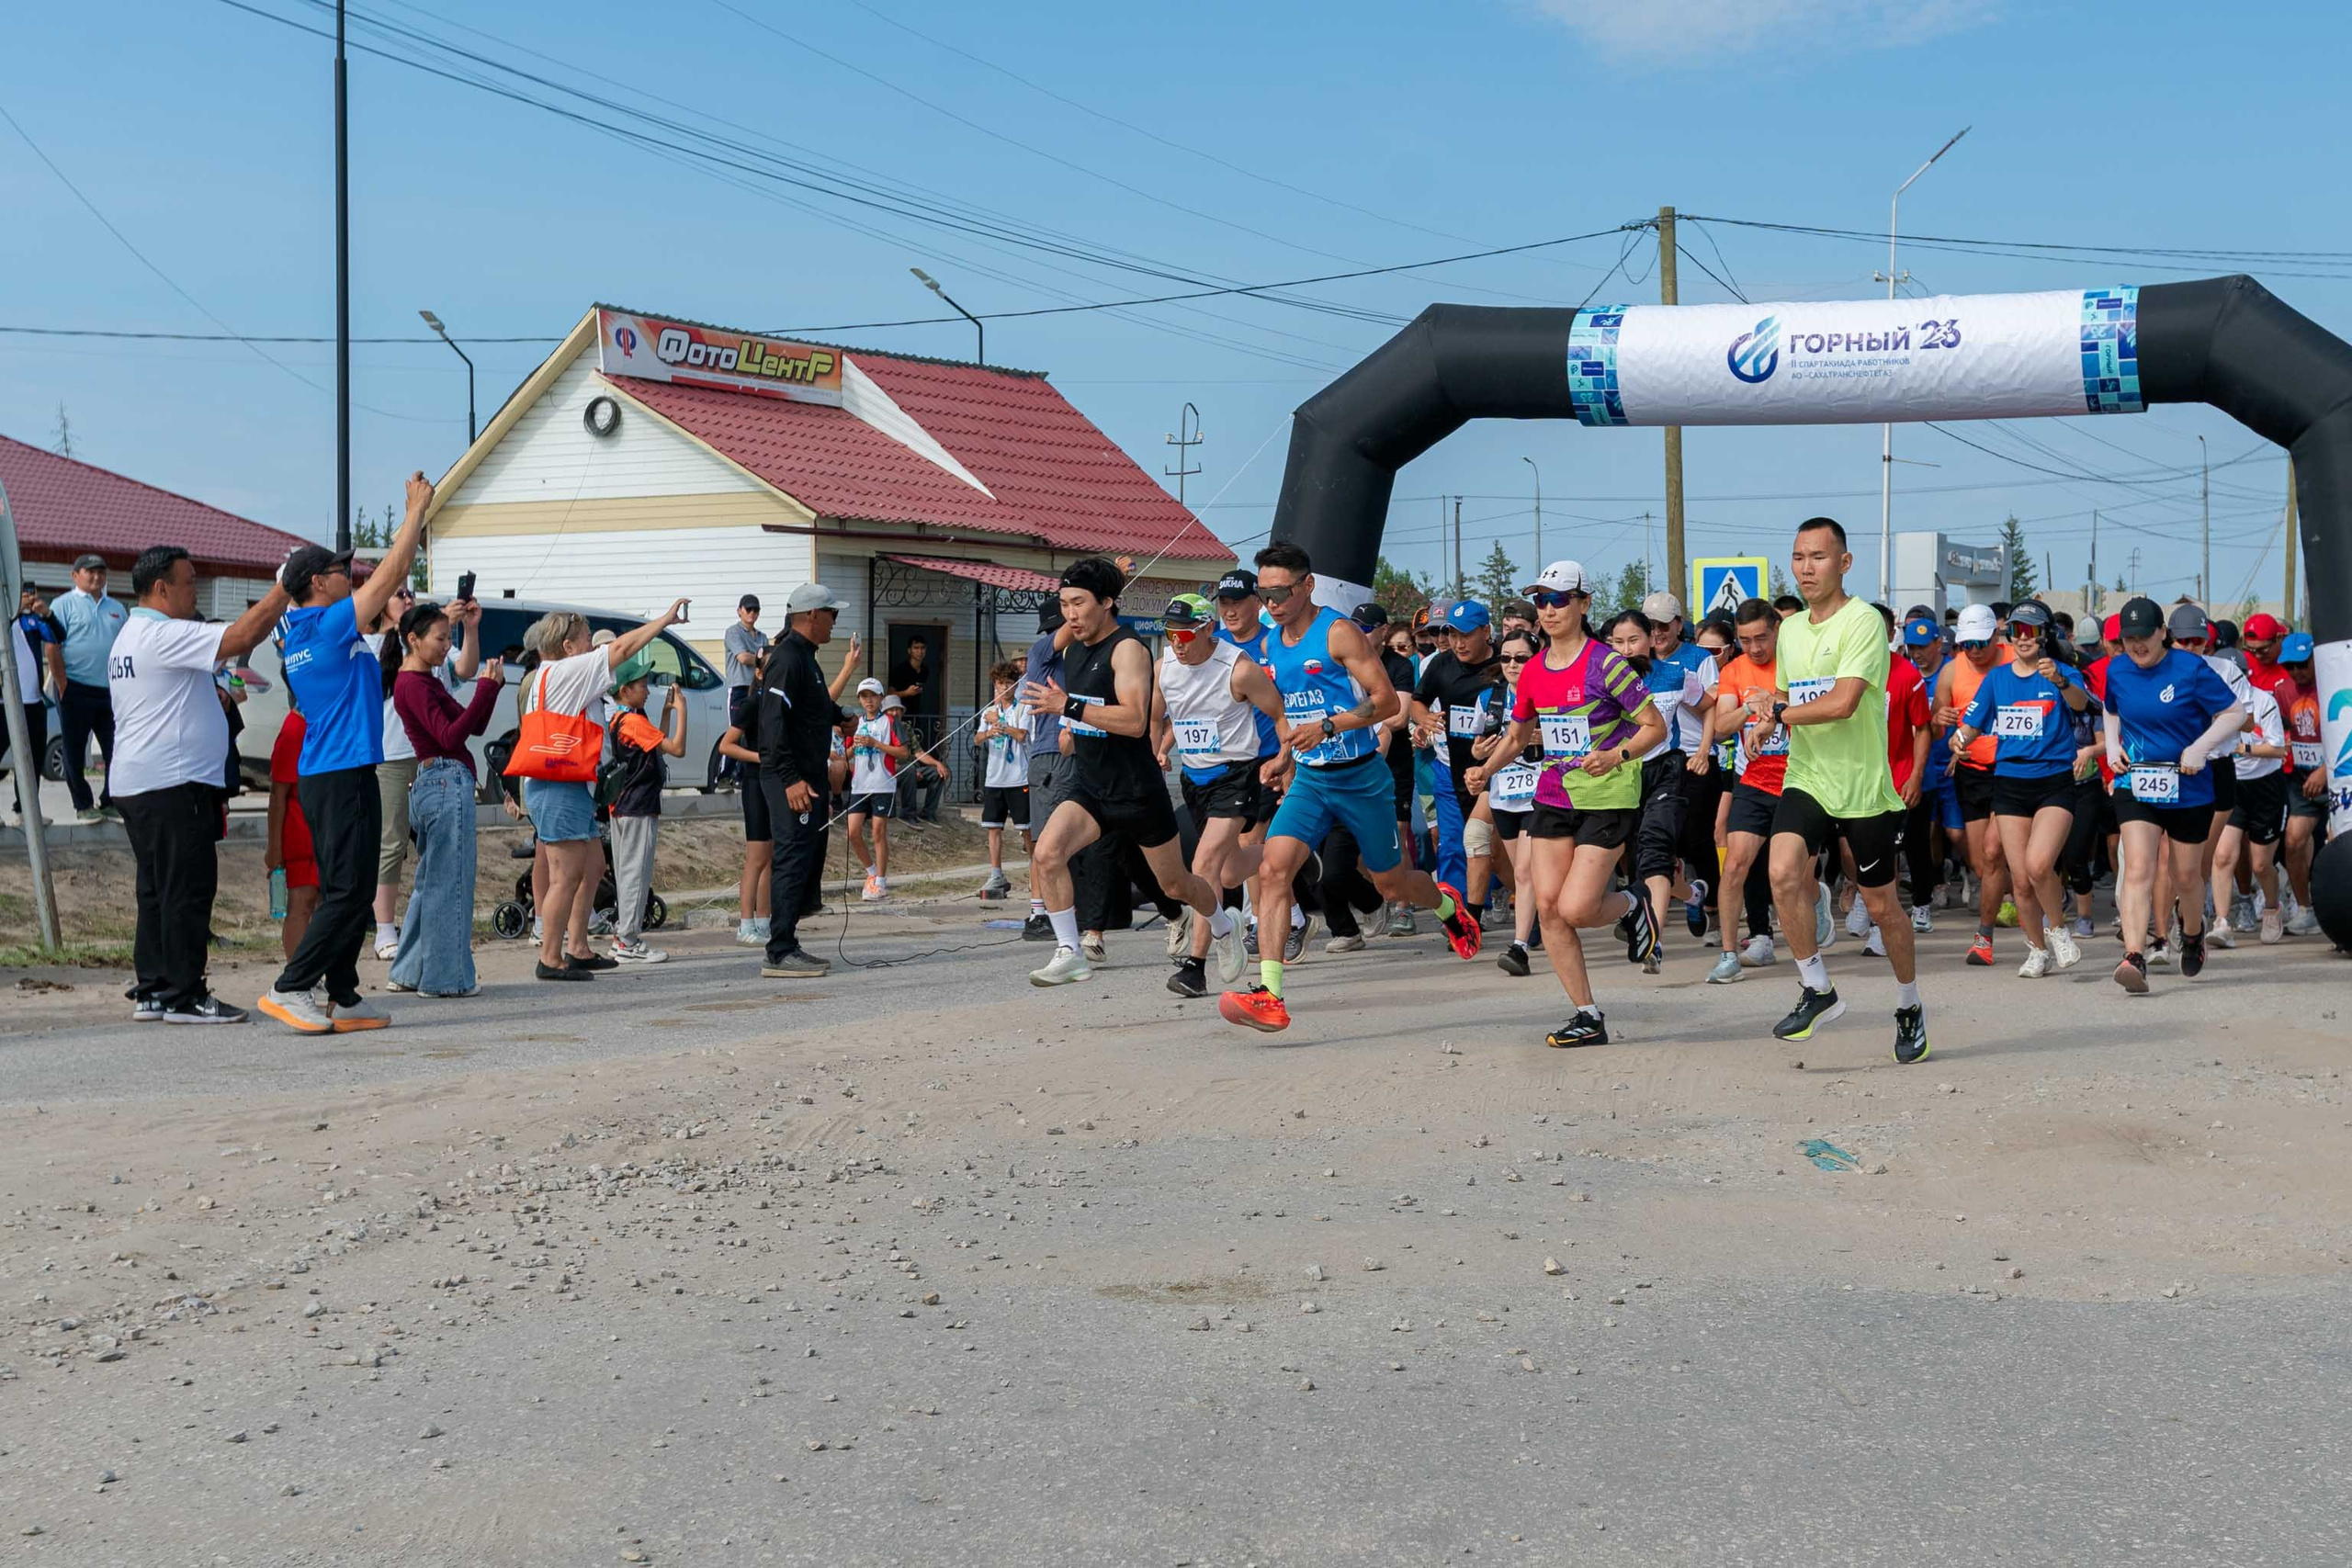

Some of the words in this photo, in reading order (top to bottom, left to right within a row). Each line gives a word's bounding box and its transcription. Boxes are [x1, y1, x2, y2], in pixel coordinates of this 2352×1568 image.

[1790, 326, 1910, 355] ГОРНЫЙ
[1799, 358, 1856, 368] СПАРТАКИАДА
[1858, 357, 1910, 367] РАБОТНИКОВ
[2006, 716, 2033, 729] 276
[1184, 729, 1208, 743] 197
[1552, 728, 1579, 744] 151
[2299, 750, 2317, 761] 121
[1507, 773, 1534, 790] 278
[2139, 777, 2168, 792] 245
